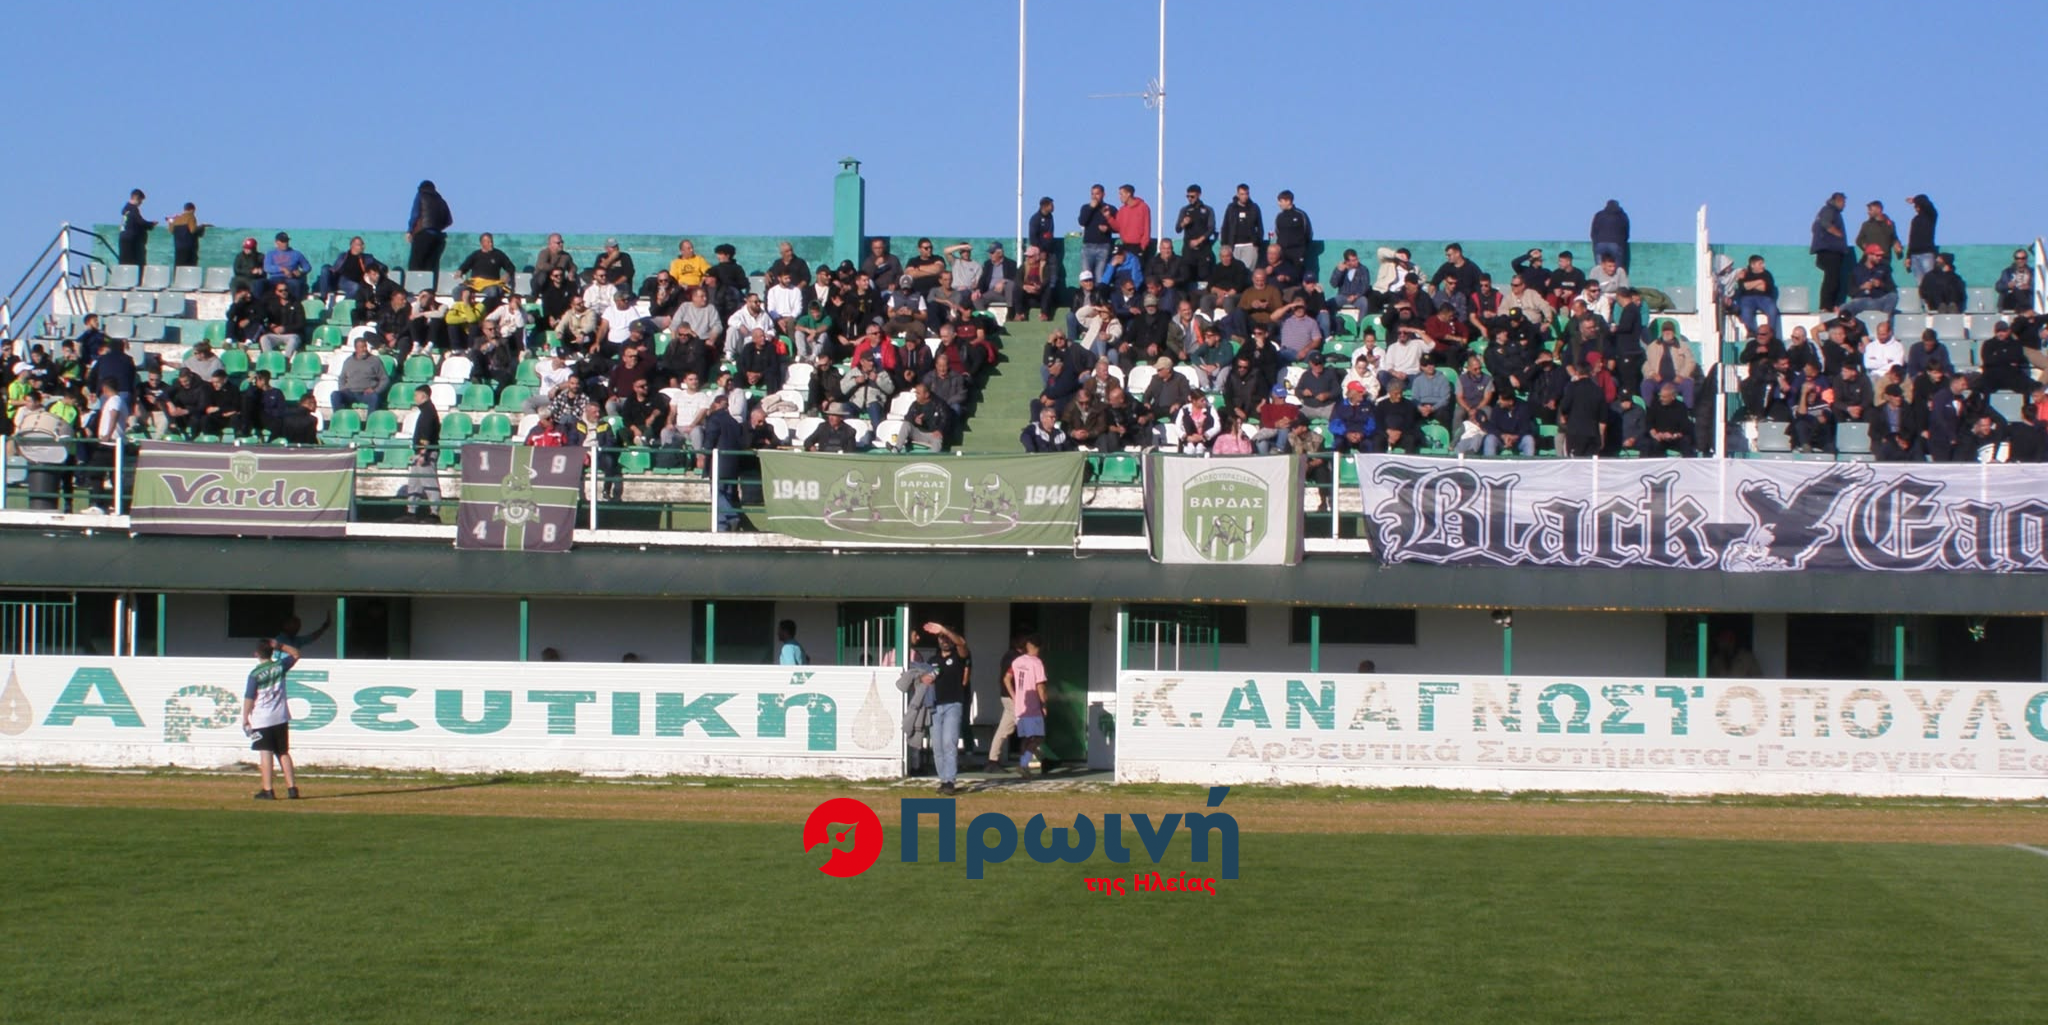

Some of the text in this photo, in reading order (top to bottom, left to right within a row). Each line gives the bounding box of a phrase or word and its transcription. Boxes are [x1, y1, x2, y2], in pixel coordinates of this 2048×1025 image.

[159, 472, 320, 509] Varda
[772, 478, 821, 501] 1948
[900, 480, 945, 489] ΒΑΡΔΑΣ
[1190, 496, 1264, 509] ΒΑΡΔΑΣ
[1373, 462, 1719, 569] Black
[42, 667, 837, 751] Αρδευτική
[1226, 735, 1461, 763] Αρδευτικά
